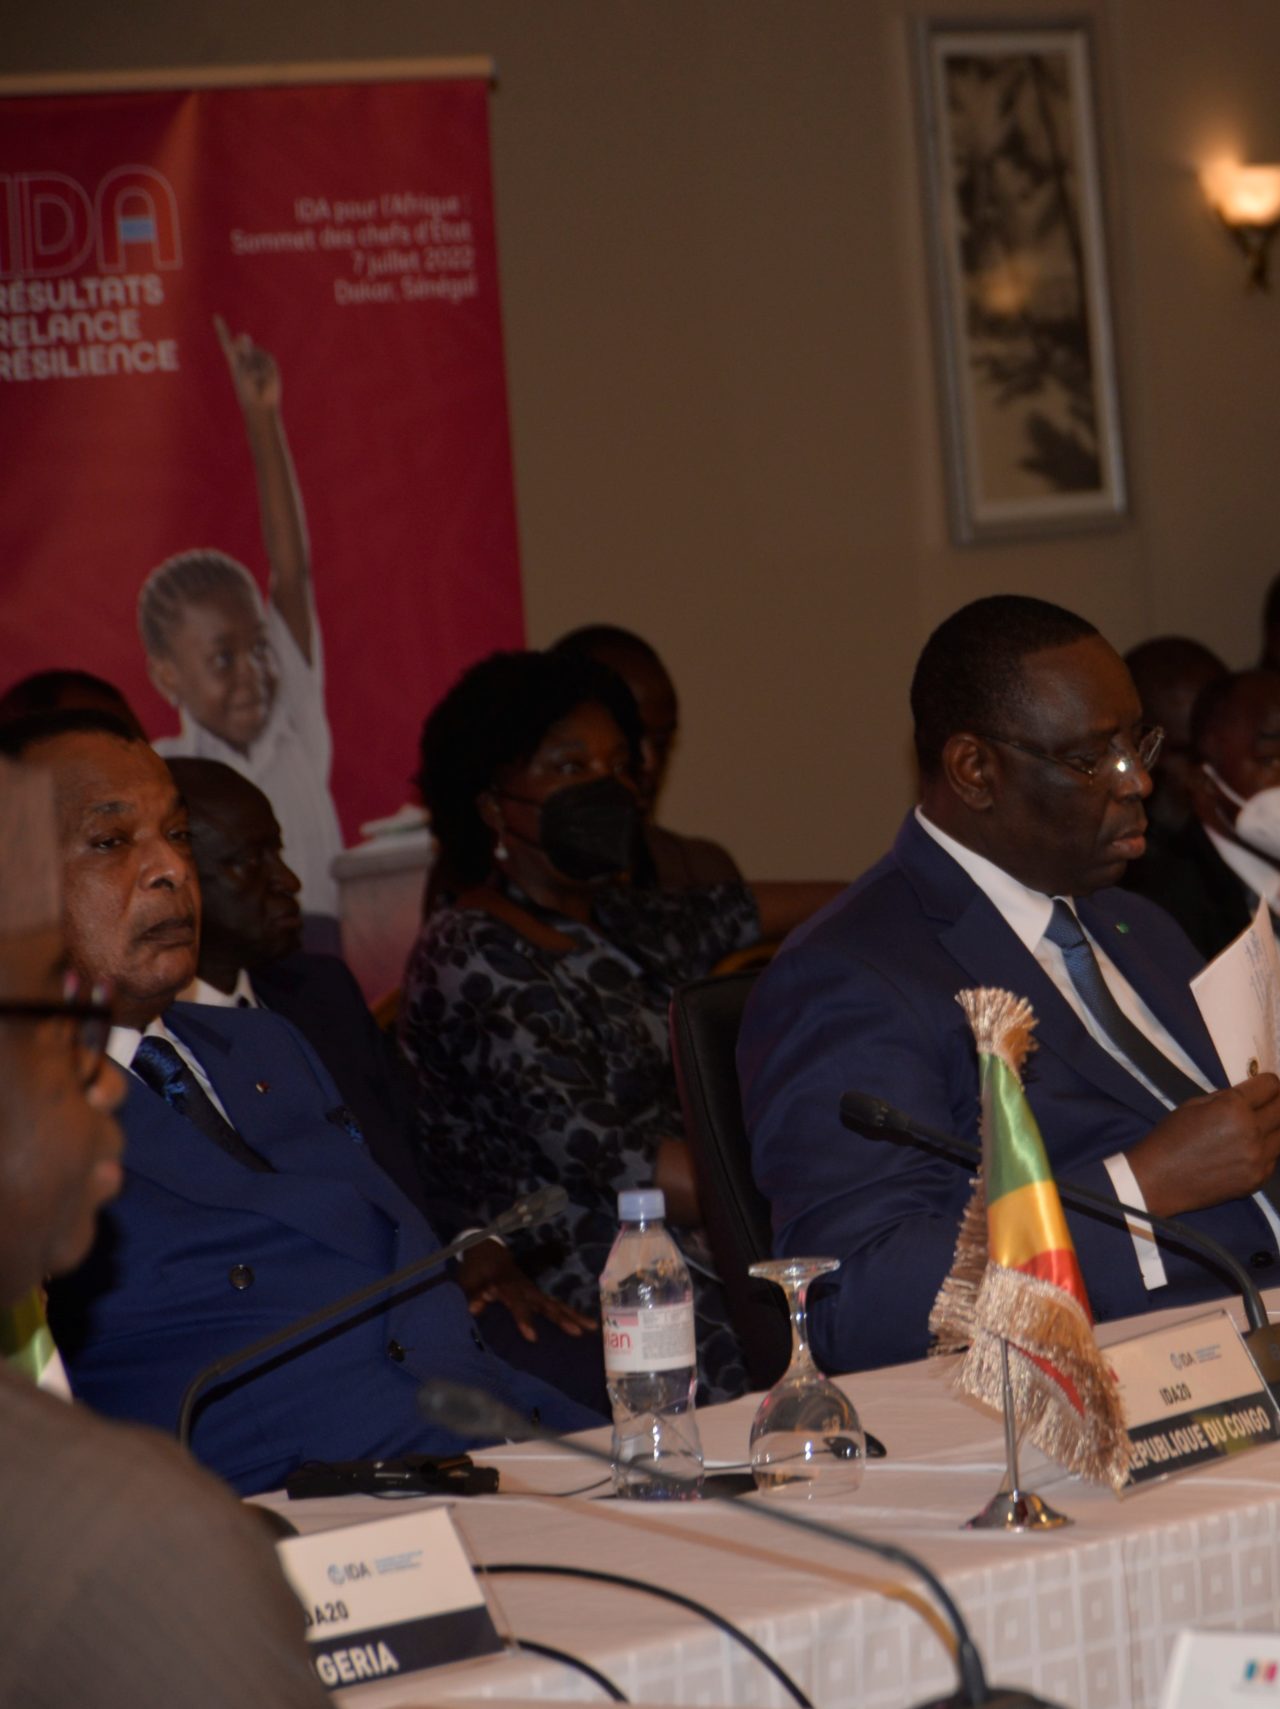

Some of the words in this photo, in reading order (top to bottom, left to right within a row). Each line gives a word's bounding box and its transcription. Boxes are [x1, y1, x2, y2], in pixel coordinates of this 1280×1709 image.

[0, 163, 183, 280] IDA
[230, 229, 315, 254] Sommet
[319, 225, 354, 249] des
[1159, 1382, 1191, 1406] IDA20
[1126, 1423, 1208, 1471] EPUBLIQUE
[1202, 1415, 1227, 1446] DU
[1224, 1404, 1271, 1438] CONGO
[344, 1561, 371, 1581] IDA
[308, 1641, 399, 1687] GERIA
